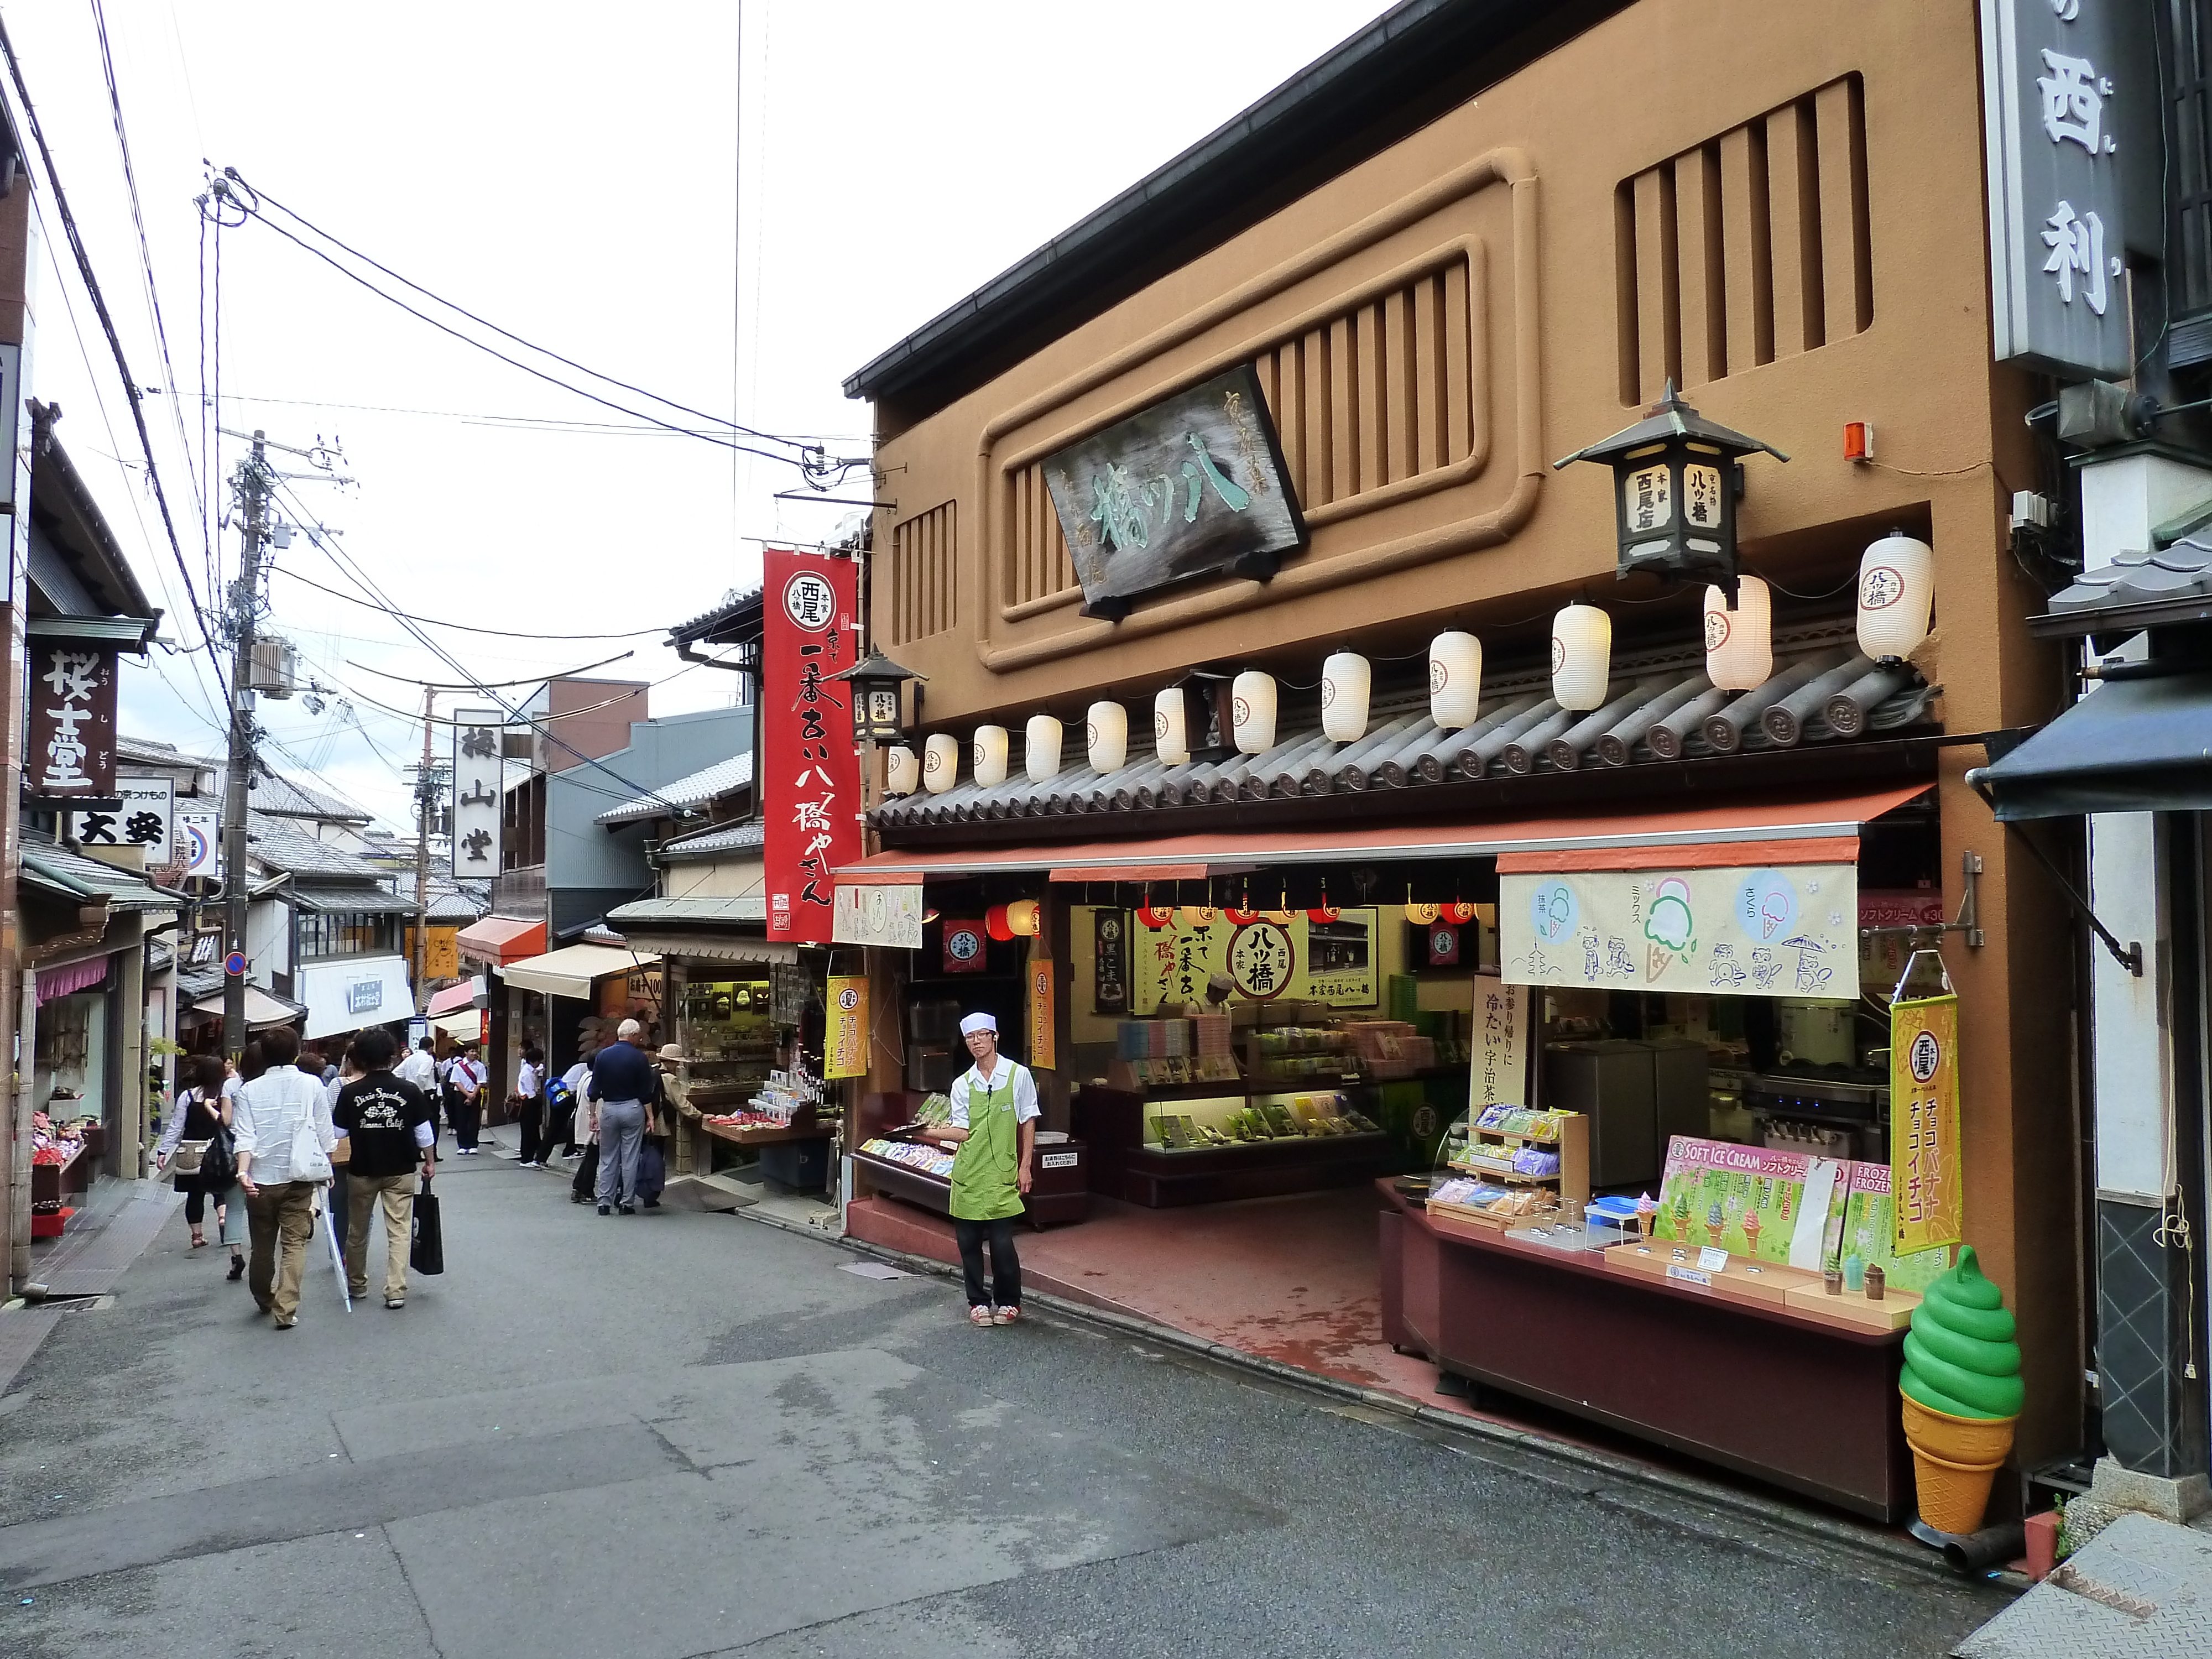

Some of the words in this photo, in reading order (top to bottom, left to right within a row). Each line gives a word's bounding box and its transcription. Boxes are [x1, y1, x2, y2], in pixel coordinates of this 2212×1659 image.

[1636, 472, 1653, 529] 西尾店
[1656, 472, 1667, 503] 本家
[1691, 471, 1708, 523] 八ツ橋
[1708, 473, 1717, 507] 京名物
[791, 589, 802, 611] 八ツ橋
[800, 581, 820, 623] 西尾
[821, 592, 830, 613] 本家
[1867, 572, 1887, 606] 八ツ橋
[42, 649, 100, 786] 桜士堂
[875, 693, 886, 720] 八ツ橋
[461, 727, 497, 862] 梅山堂
[80, 811, 164, 844] 大安
[1537, 894, 1546, 914] 抹茶
[1631, 885, 1641, 924] ミックス
[1745, 887, 1756, 918] さくら
[1859, 909, 1918, 921] ソフトクリーム
[957, 933, 971, 958] 八ツ橋
[1235, 949, 1245, 970] 本家
[1246, 927, 1276, 992] 八ツ橋
[1277, 948, 1287, 969] 西尾
[836, 1017, 846, 1067] チョコイチゴ
[846, 1016, 857, 1066] チョコバナナ
[1483, 993, 1503, 1105] 冷たい宇治茶
[1917, 1039, 1930, 1076] 西尾
[1684, 1142, 1710, 1162] SOFT
[1710, 1146, 1726, 1165] ICE
[1726, 1149, 1761, 1171] CREAM
[1907, 1100, 1923, 1224] チョコイチゴ
[1923, 1098, 1941, 1221] チョコバナナ
